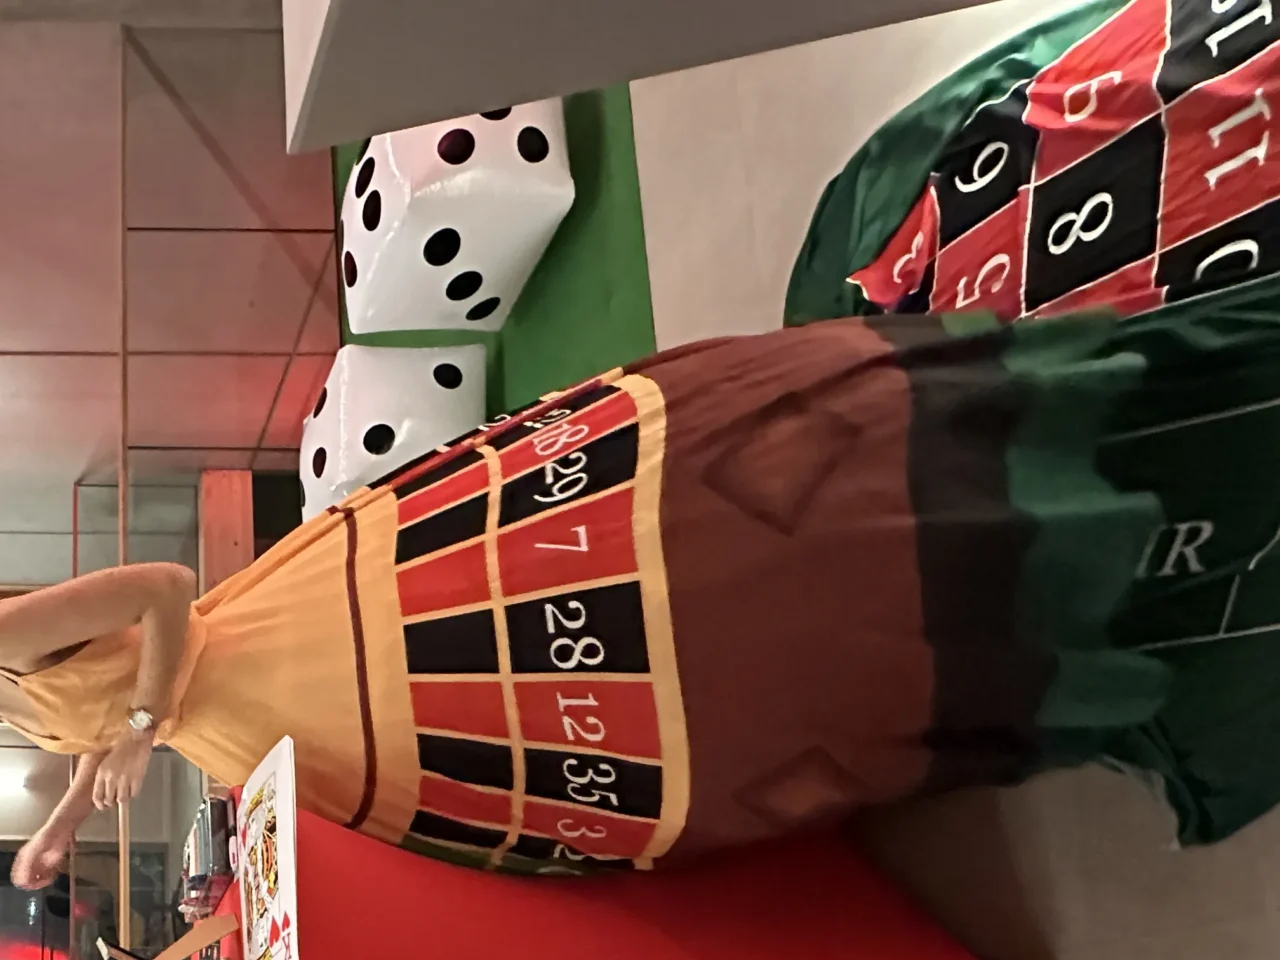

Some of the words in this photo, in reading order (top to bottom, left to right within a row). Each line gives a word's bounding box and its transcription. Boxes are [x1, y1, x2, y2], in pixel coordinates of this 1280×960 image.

[1205, 0, 1272, 57] 1
[1204, 87, 1272, 191] 11
[954, 141, 1010, 194] 6
[1047, 192, 1114, 255] 8
[956, 253, 1011, 310] 5
[533, 423, 589, 456] 18
[533, 451, 588, 503] 29
[534, 527, 590, 553] 7
[545, 600, 605, 670] 28
[556, 691, 607, 742] 12
[563, 757, 619, 807] 35
[557, 818, 607, 838] 3
